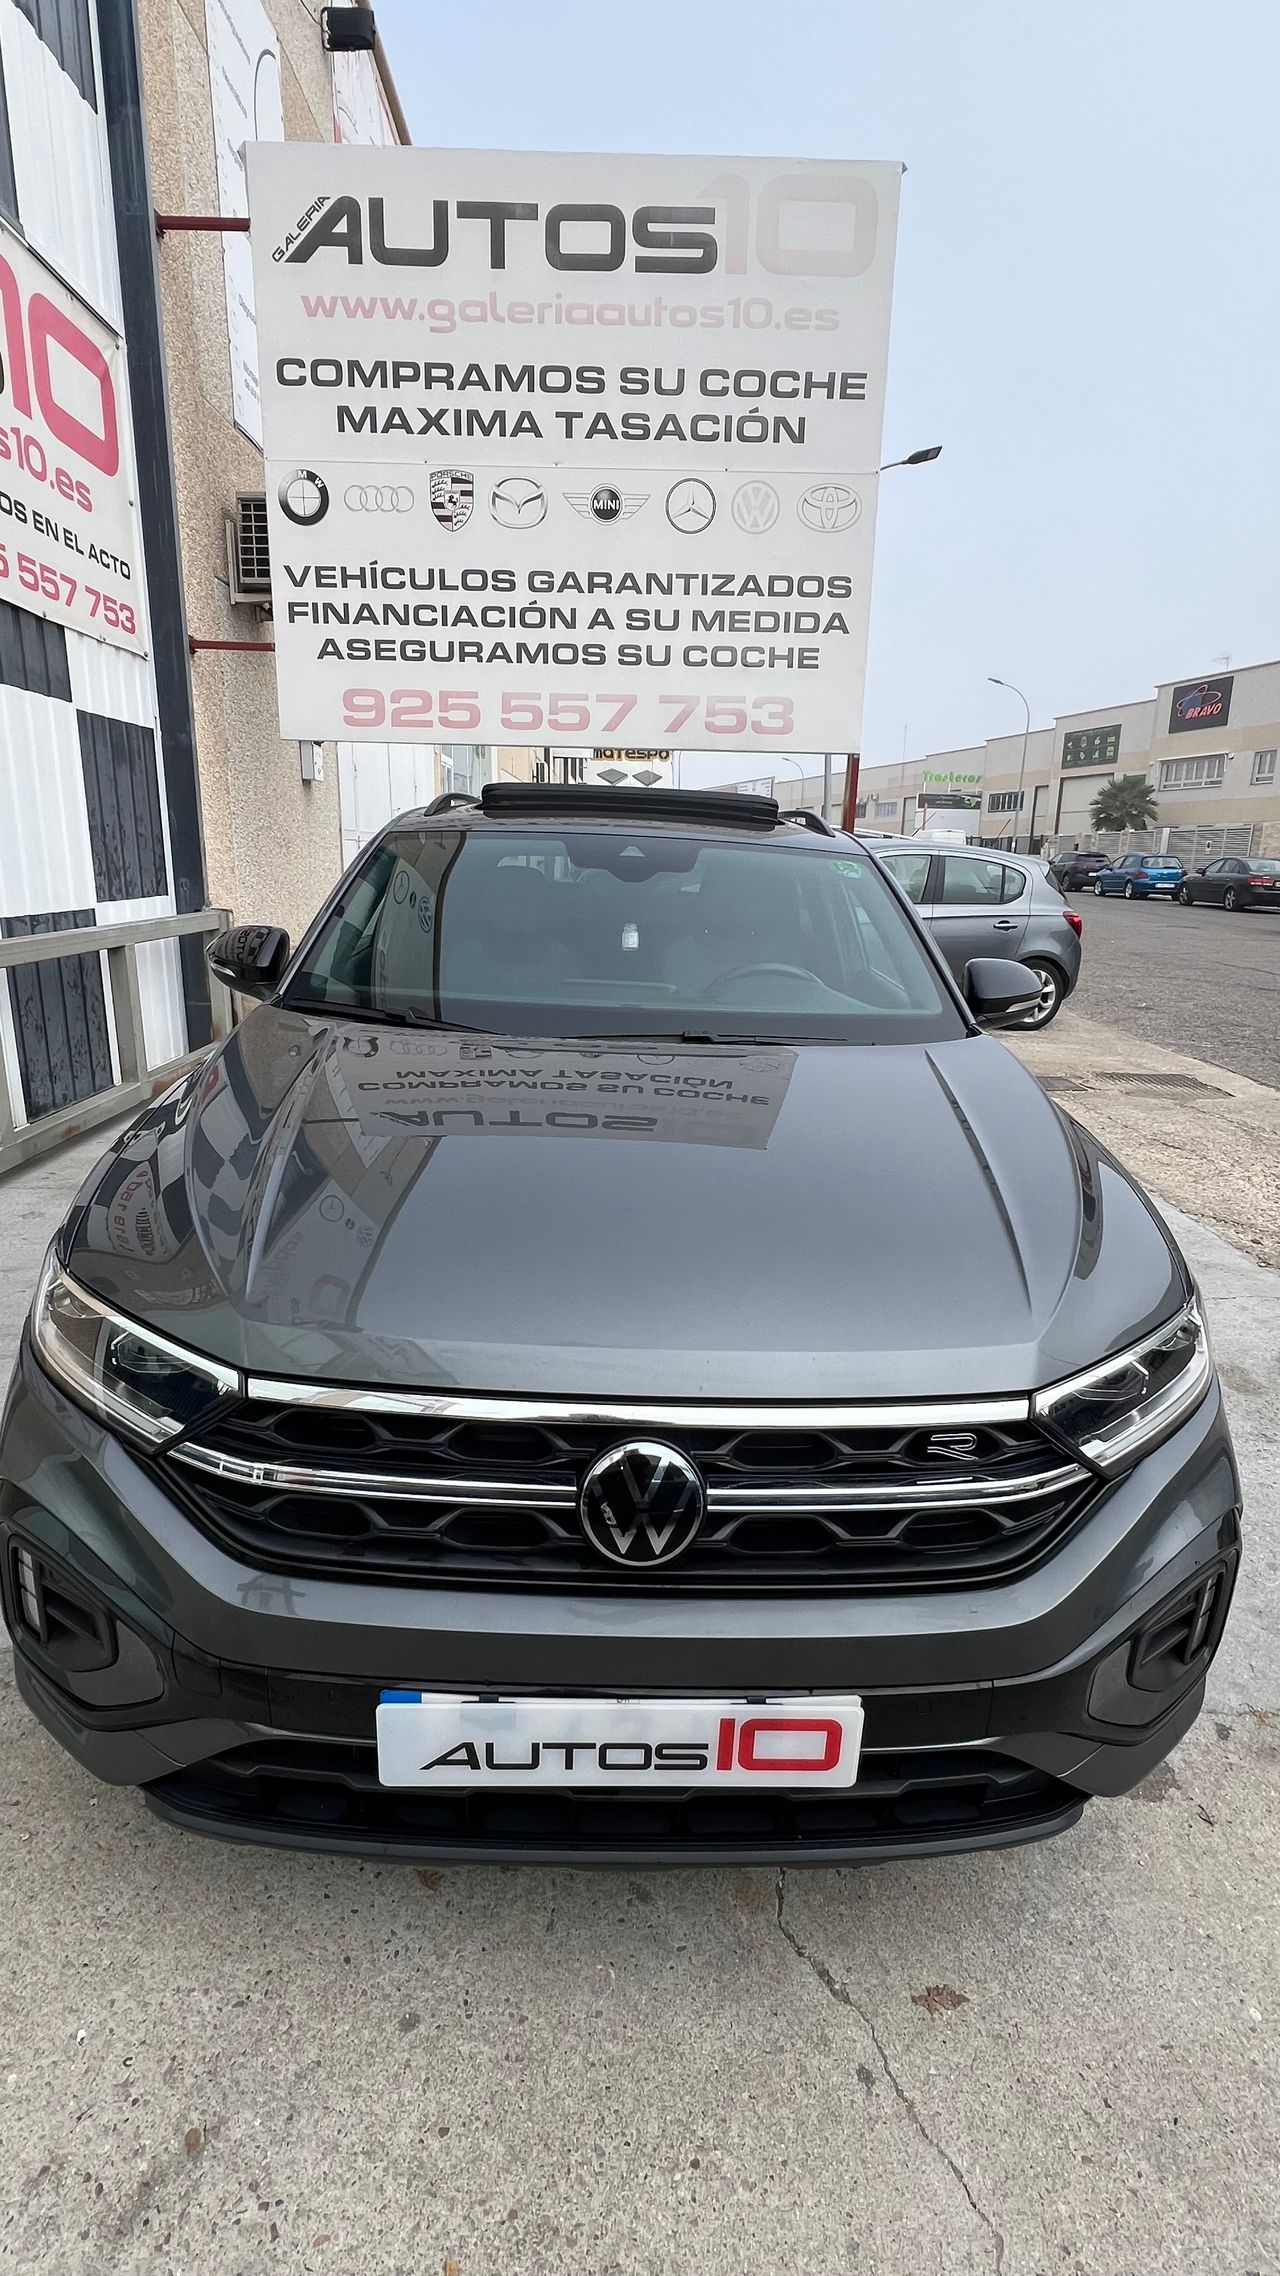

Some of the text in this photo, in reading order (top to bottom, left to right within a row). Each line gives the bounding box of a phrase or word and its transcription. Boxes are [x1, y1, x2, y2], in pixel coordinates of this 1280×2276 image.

[271, 196, 331, 263] GALERIA
[301, 293, 840, 333] www.galeriaautos10.es
[0, 256, 119, 477] 10
[276, 357, 605, 395] COMPRAMOS
[619, 366, 686, 396] SU
[699, 368, 868, 401] COCHE
[336, 405, 806, 444] MAXIMA TASACIÓN
[593, 499, 619, 511] MINI
[32, 509, 60, 543] EN
[62, 526, 85, 556] EL
[88, 543, 131, 581] ACTO
[17, 551, 78, 607] 557
[84, 586, 136, 635] 753
[283, 559, 852, 599] VEHÍCULOS GARANTIZADOS
[287, 599, 850, 635] FINANCIACIÓN A SU MEDIDA
[316, 638, 820, 670] ASEGURAMOS SU COCHE
[341, 687, 794, 737] 925 557 753
[1185, 702, 1223, 720] BRAVO
[923, 769, 982, 784] Trasteros
